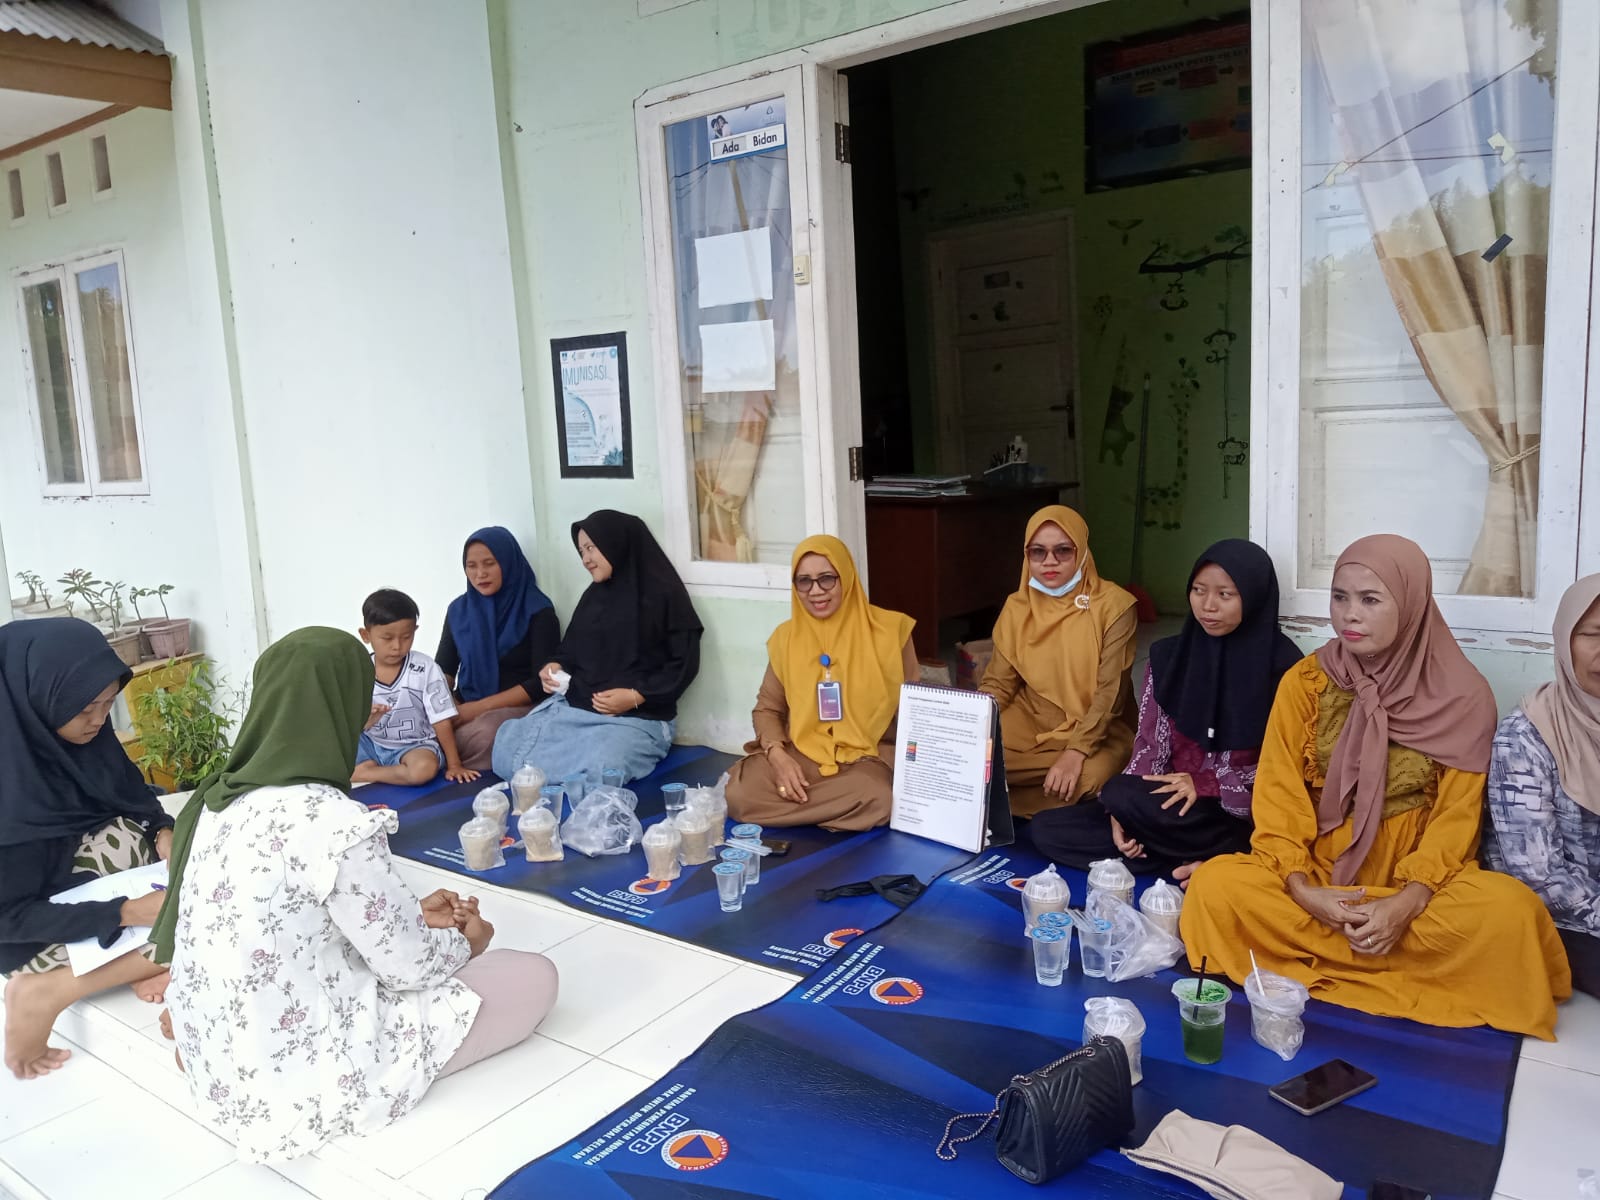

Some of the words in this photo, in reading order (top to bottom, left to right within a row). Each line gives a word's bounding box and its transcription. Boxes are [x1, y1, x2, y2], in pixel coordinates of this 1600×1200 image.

[722, 141, 740, 154] Ada
[752, 131, 778, 147] Bidan
[562, 365, 608, 386] IMUNISASI
[842, 965, 886, 996] BNPB
[661, 1083, 684, 1098] TIDAK
[663, 1087, 697, 1110] BANTUAN
[639, 1096, 665, 1113] UNTUK
[603, 1111, 642, 1139] DIPERJUAL
[622, 1108, 667, 1141] PEMERINTAH
[629, 1112, 690, 1154] BNPB
[572, 1137, 606, 1160] BELIKAN
[583, 1138, 625, 1166] INDONESIA
